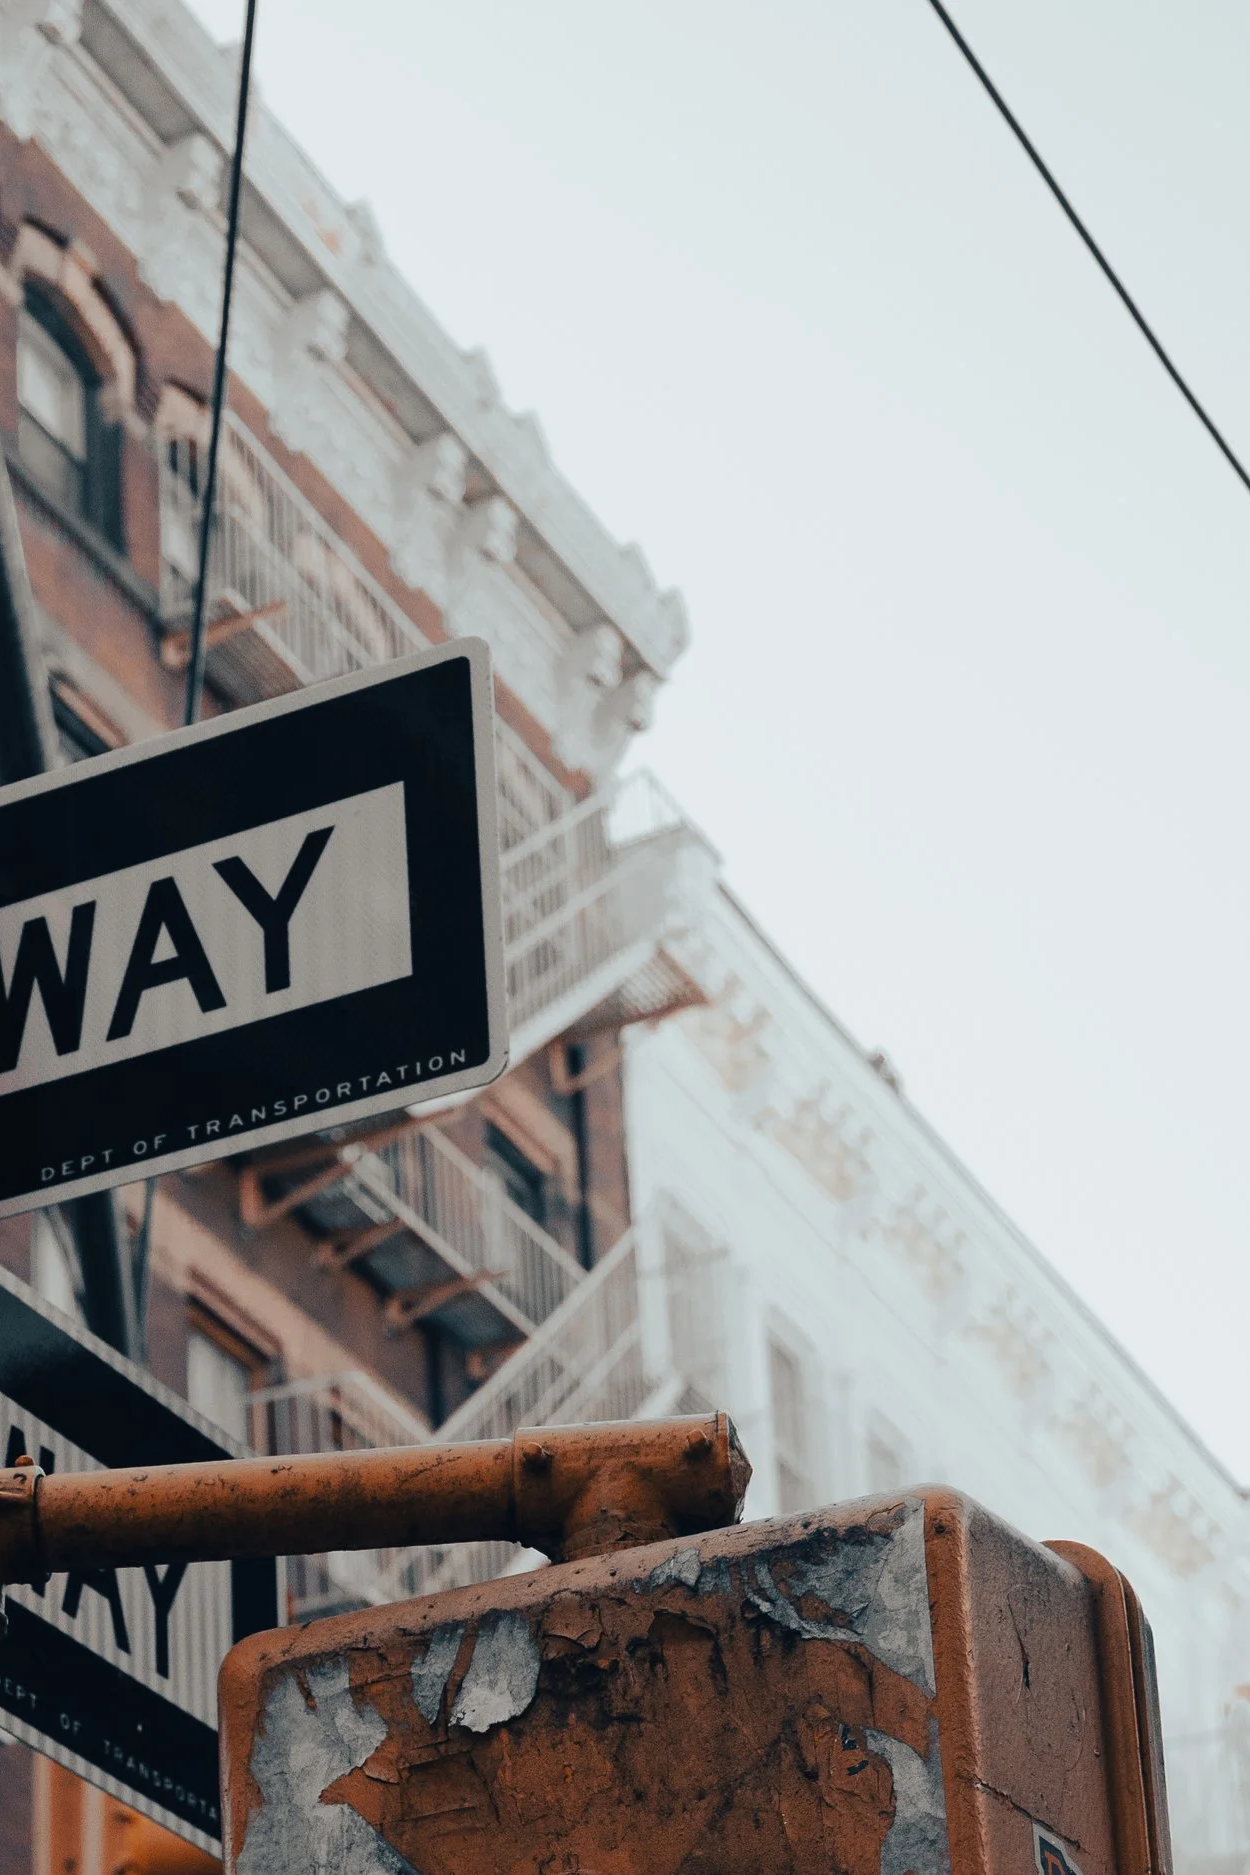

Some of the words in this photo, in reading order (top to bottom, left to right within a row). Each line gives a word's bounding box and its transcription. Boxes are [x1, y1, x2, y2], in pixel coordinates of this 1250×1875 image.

[41, 1148, 114, 1182] DEPT
[133, 1134, 167, 1156] OF
[187, 1048, 467, 1141] TRANSPORTATION
[59, 1712, 82, 1737] OF
